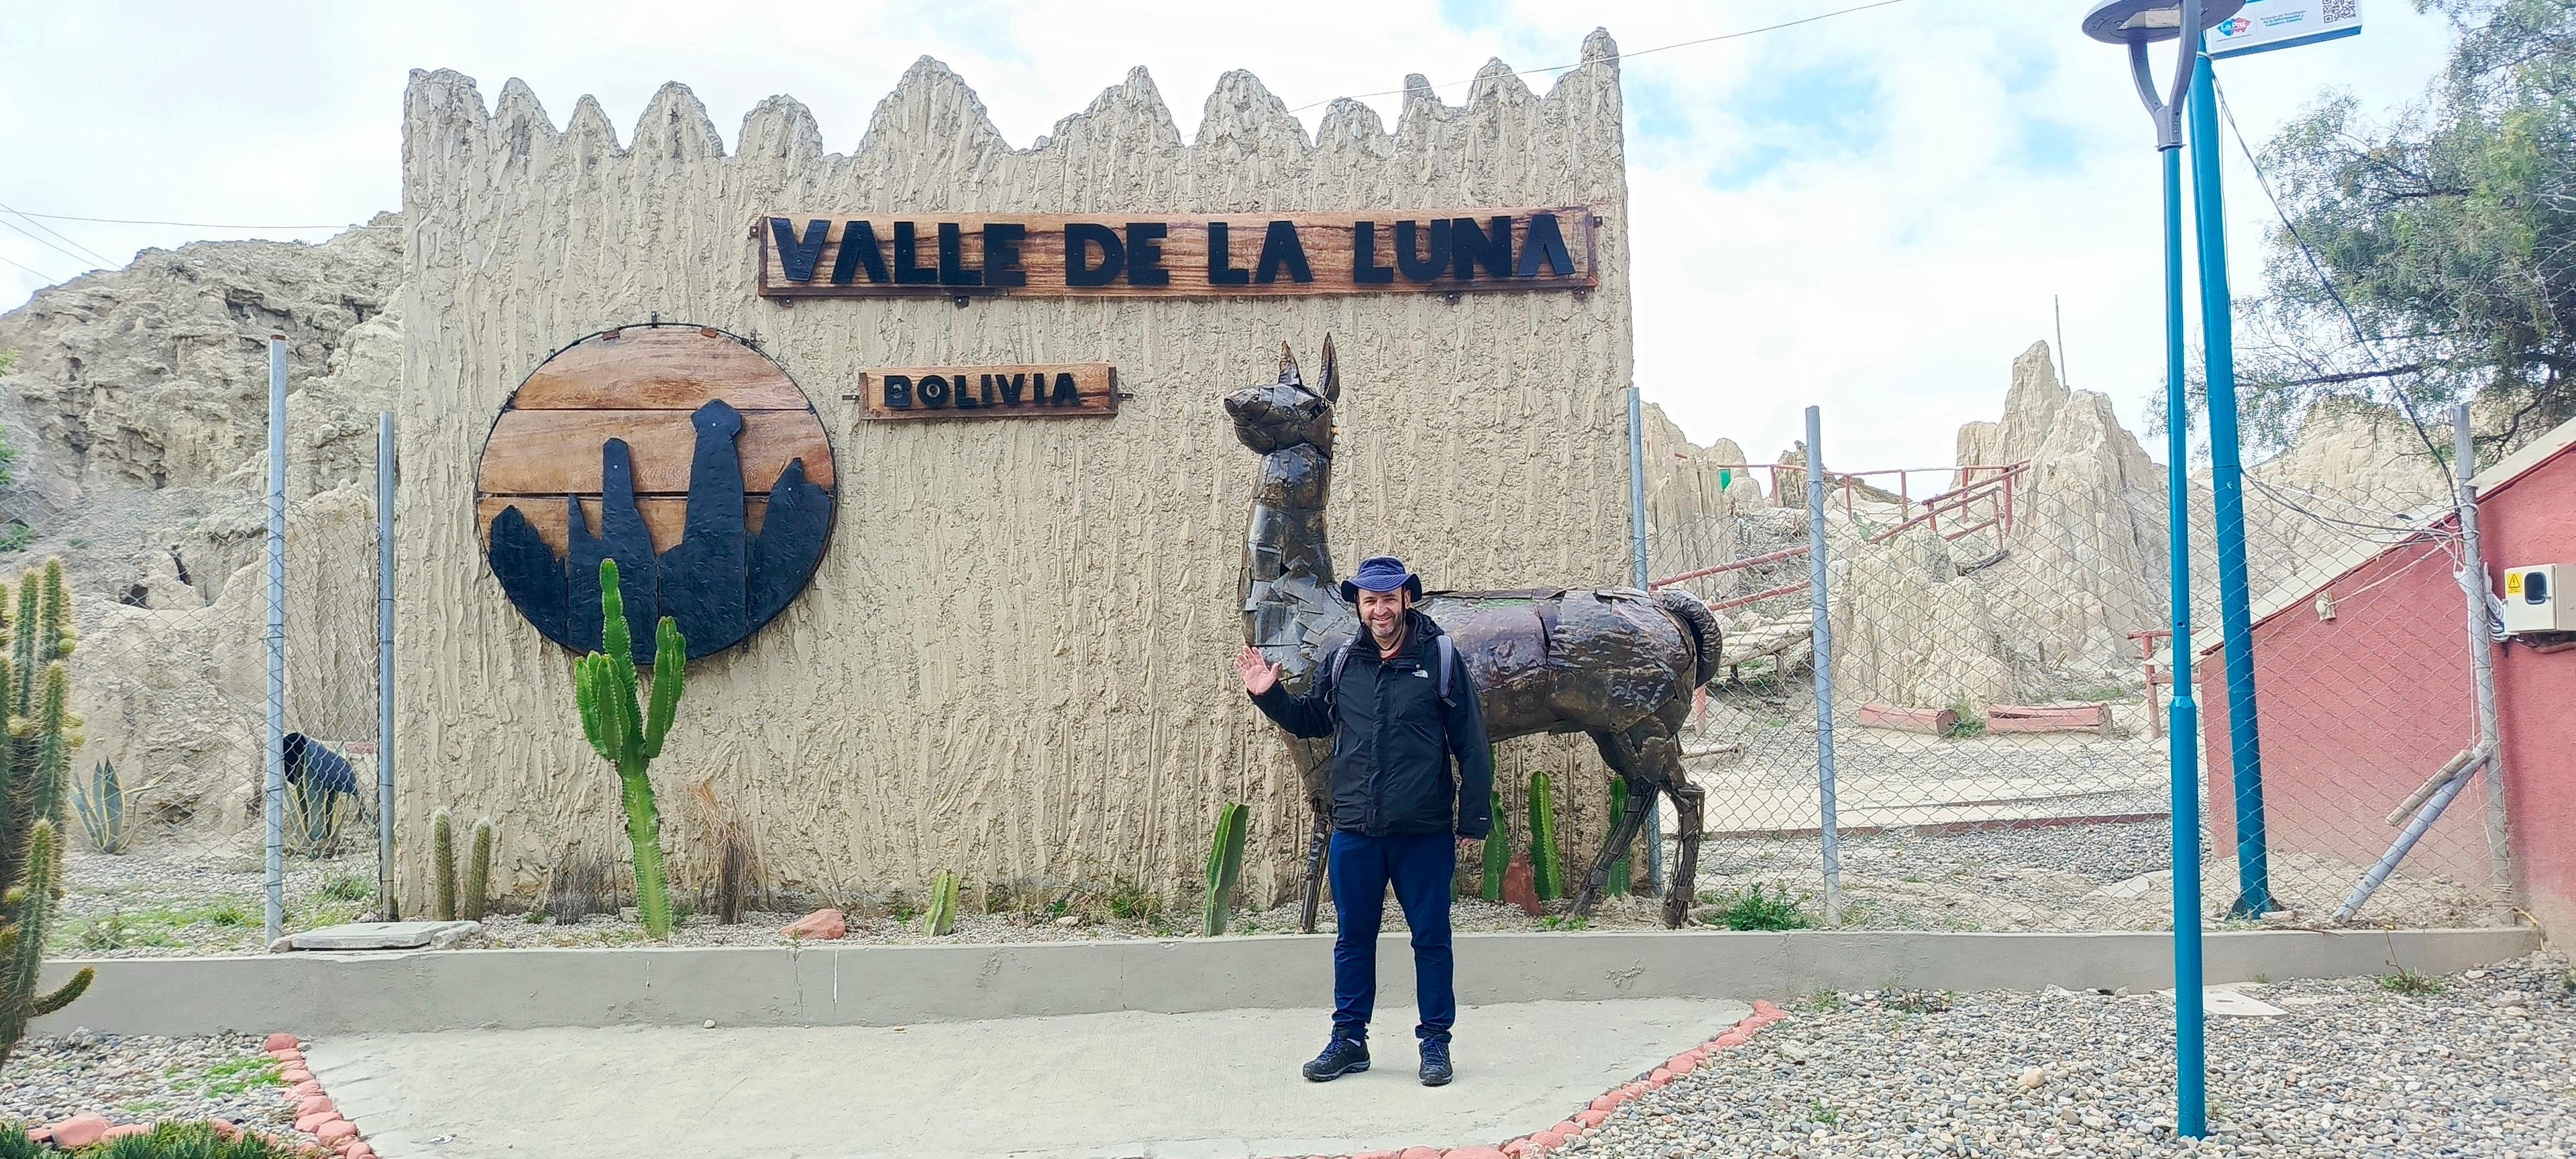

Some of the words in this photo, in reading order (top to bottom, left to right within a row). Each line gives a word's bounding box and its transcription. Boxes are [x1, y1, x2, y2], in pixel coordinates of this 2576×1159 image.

[769, 217, 1026, 286] VALLE
[1065, 222, 1169, 286] DE
[1208, 221, 1314, 285] LA
[1354, 213, 1576, 283] LUNA
[884, 372, 1081, 408] BOLIVIA
